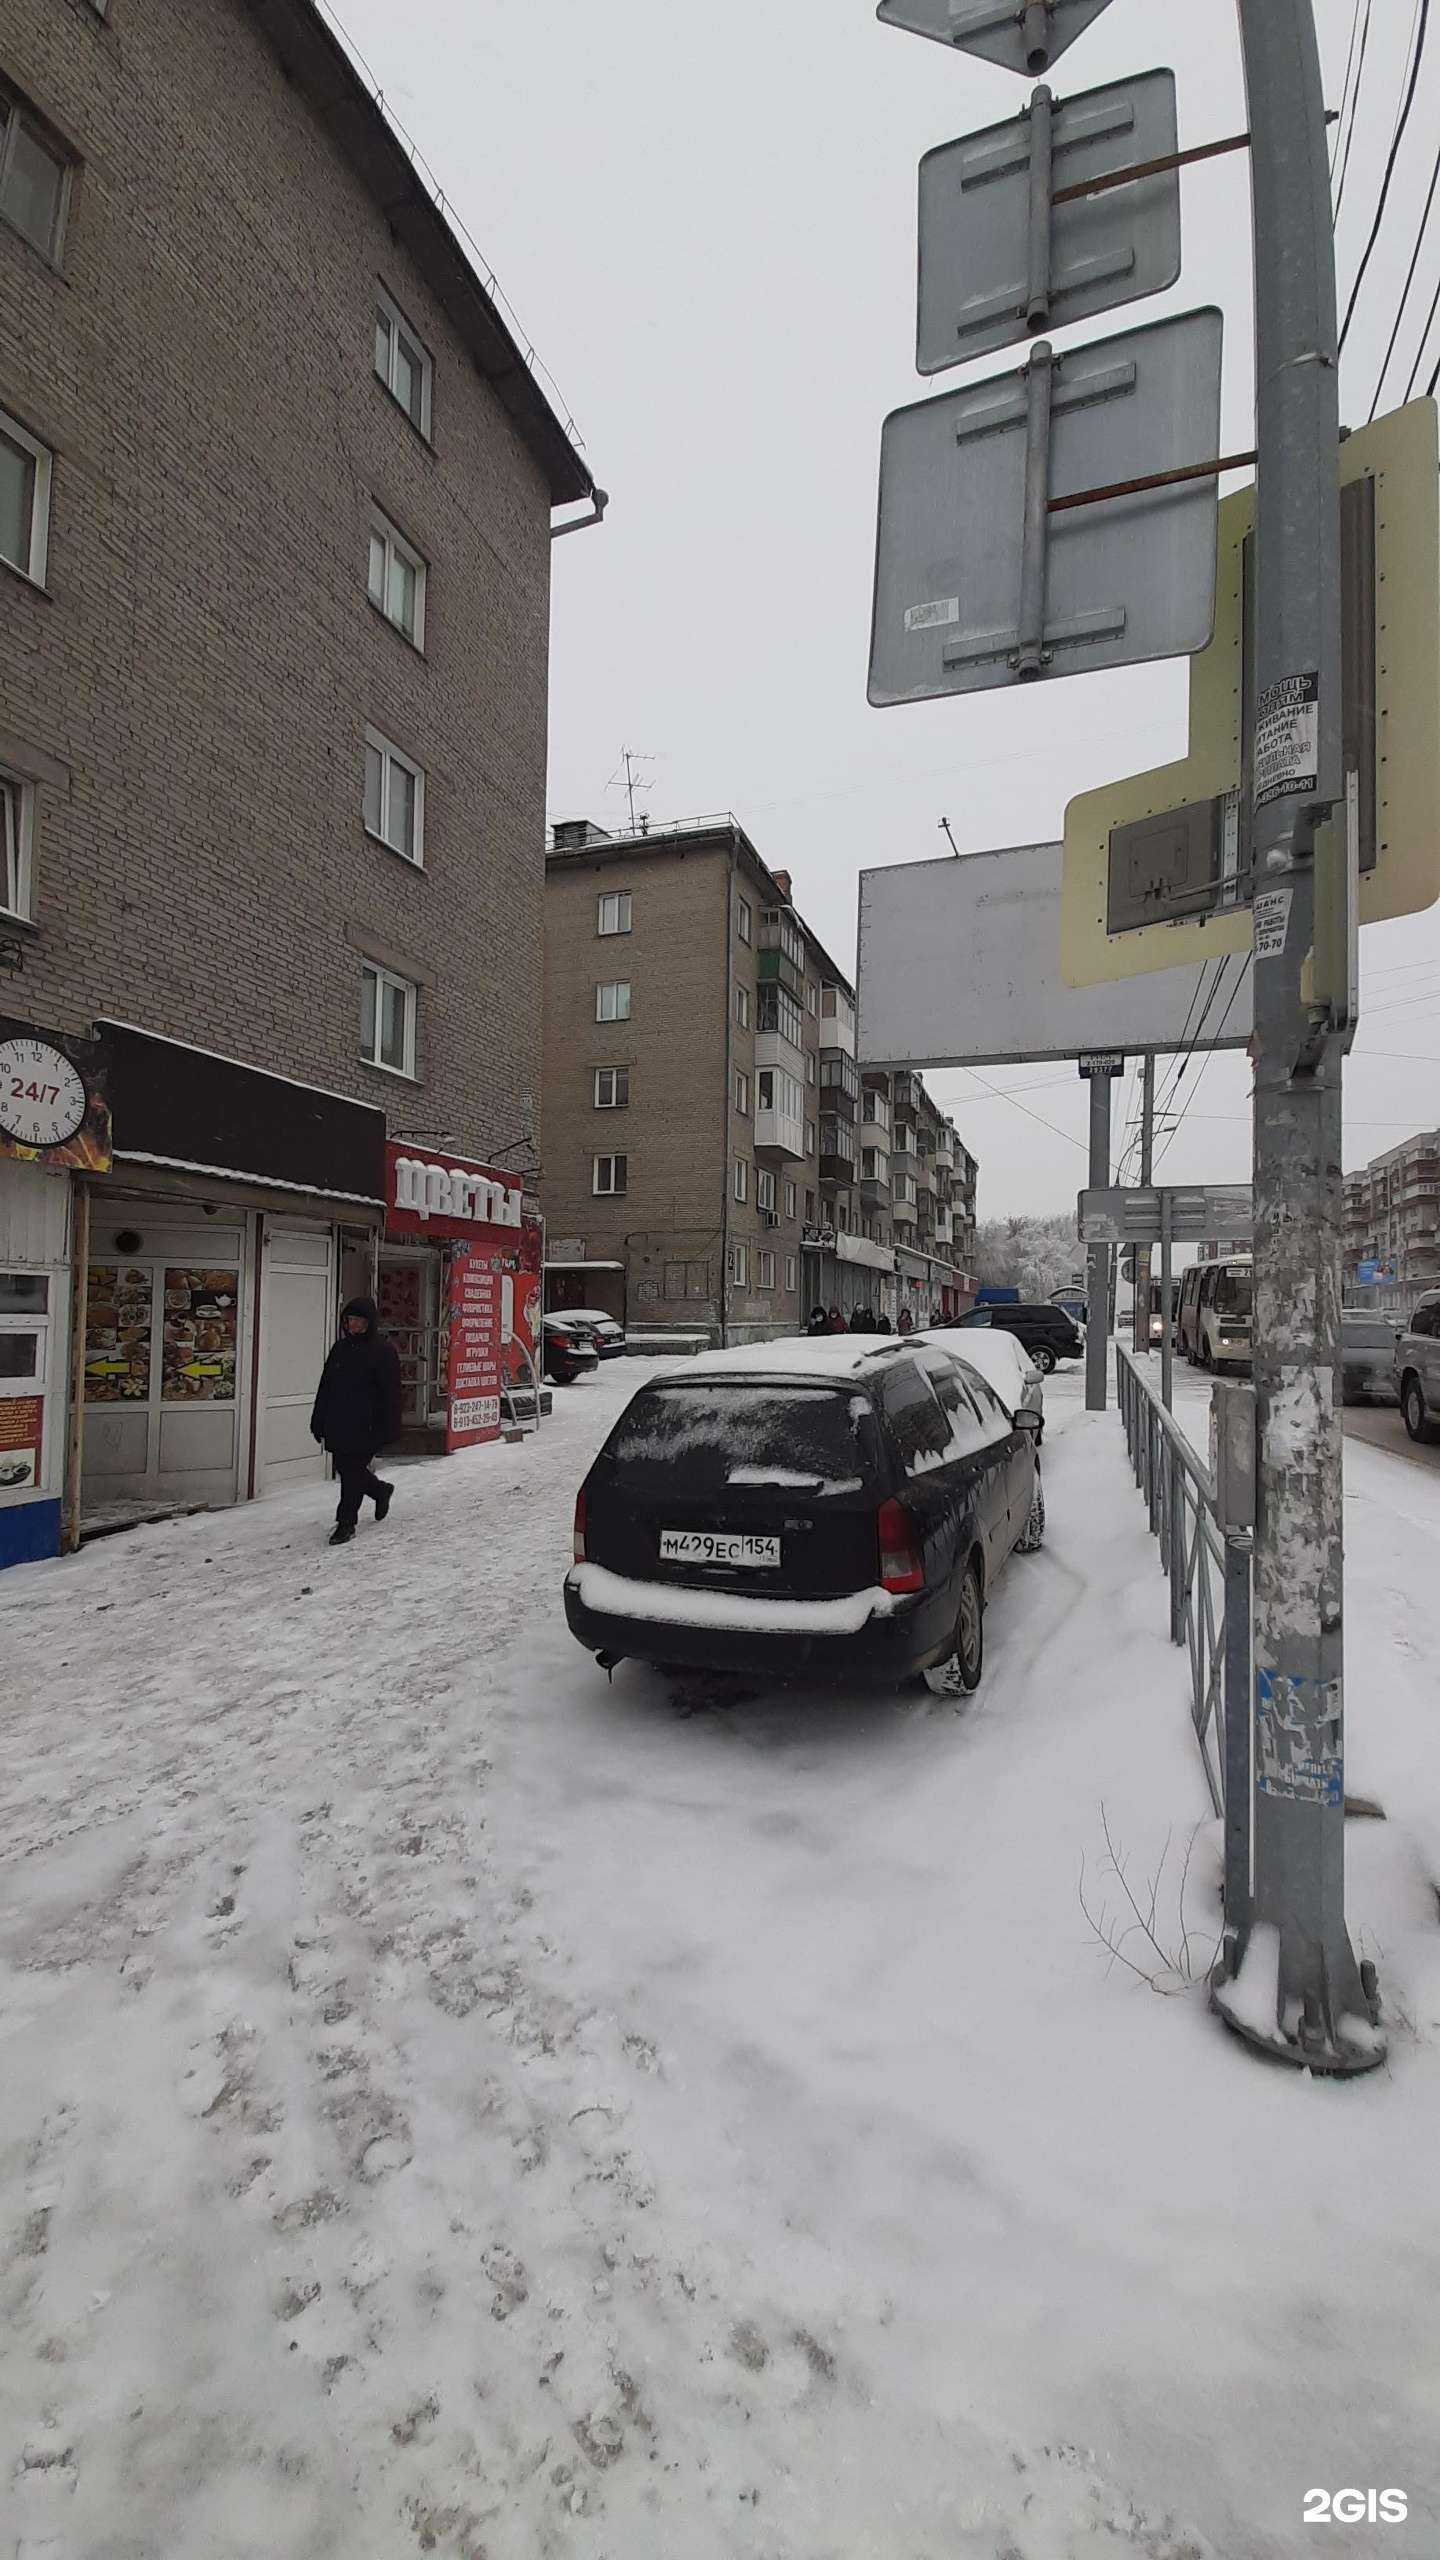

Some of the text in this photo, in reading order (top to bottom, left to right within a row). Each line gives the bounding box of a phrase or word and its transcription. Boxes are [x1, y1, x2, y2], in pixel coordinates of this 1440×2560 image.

[1257, 676, 1313, 707] МОЩЬ
[1257, 733, 1293, 756] АБОТА
[15, 1052, 24, 1063] 11
[31, 1051, 42, 1063] 12
[10, 1077, 60, 1105] 24/7
[33, 1122, 40, 1132] 6
[395, 1157, 522, 1228] ЦВЕТЫ
[745, 1538, 775, 1556] 154
